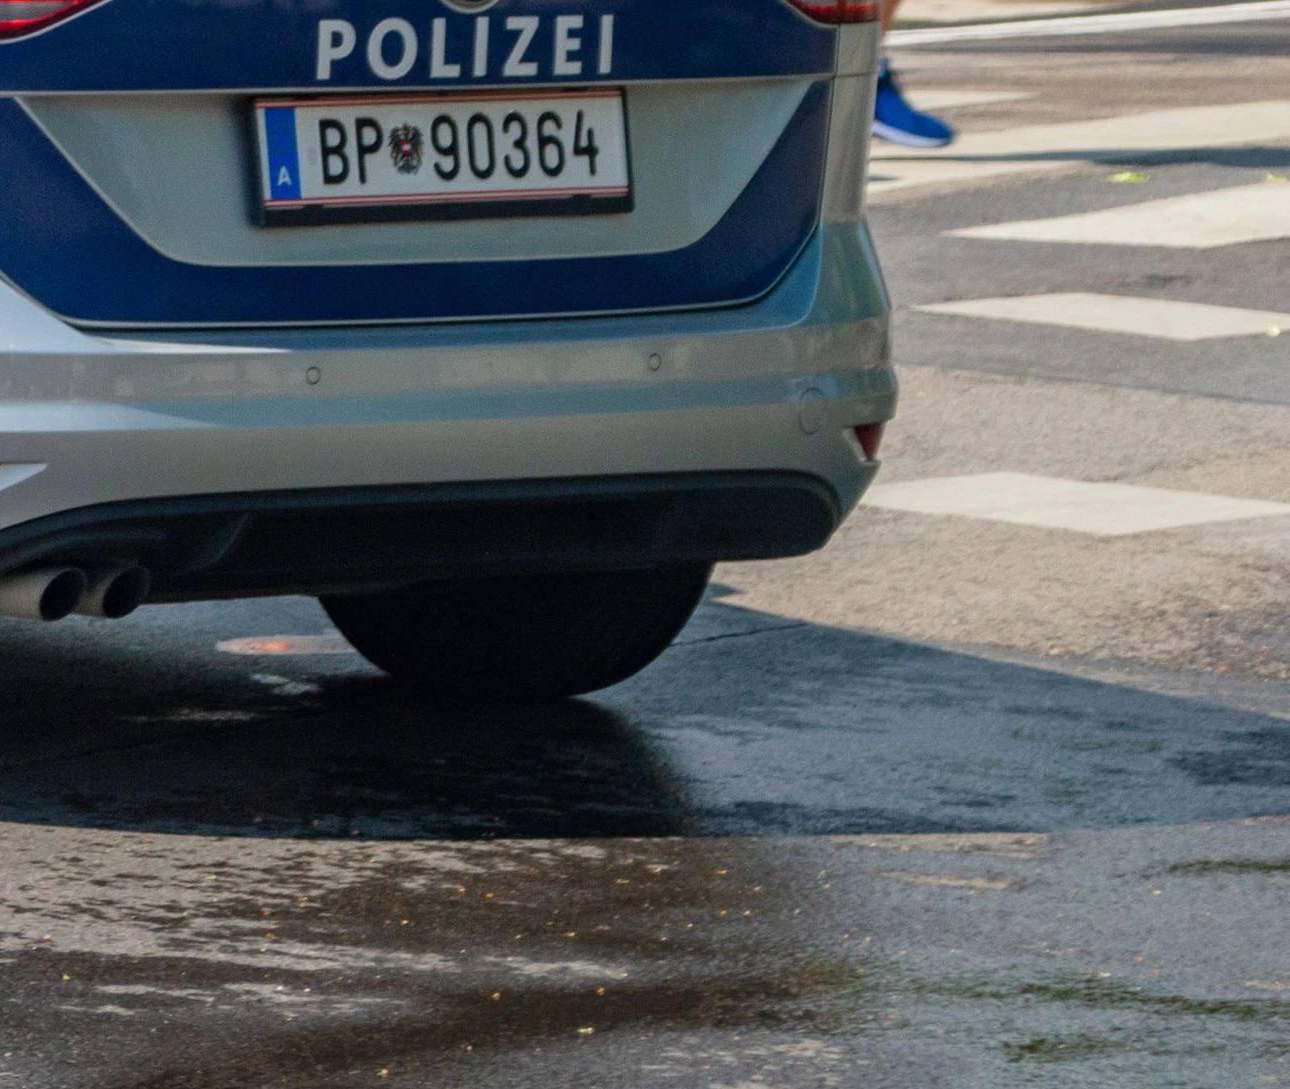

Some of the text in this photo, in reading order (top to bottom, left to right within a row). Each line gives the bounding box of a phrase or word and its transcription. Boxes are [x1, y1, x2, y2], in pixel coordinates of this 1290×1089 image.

[316, 14, 615, 81] POLIZEI
[277, 165, 292, 186] A
[319, 109, 599, 185] BP 90364
